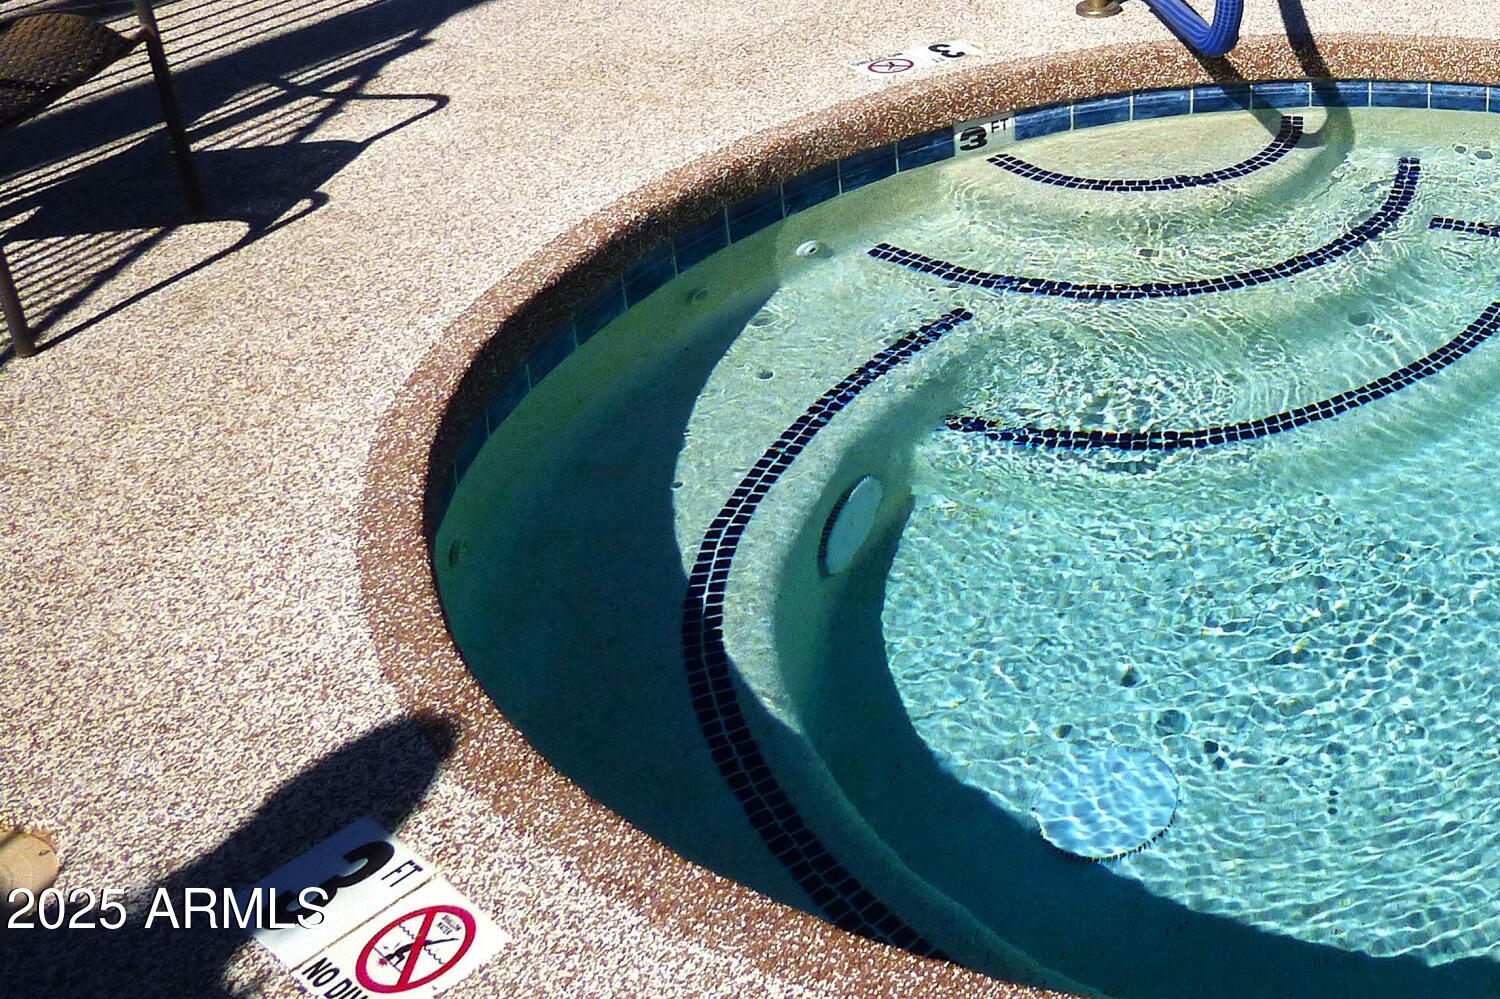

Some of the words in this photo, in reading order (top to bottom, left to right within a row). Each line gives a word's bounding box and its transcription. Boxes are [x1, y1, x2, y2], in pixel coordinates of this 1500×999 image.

[928, 43, 966, 59] 3
[959, 126, 988, 151] 3
[991, 118, 1009, 134] FT
[380, 859, 424, 888] FT
[301, 957, 341, 988] NO
